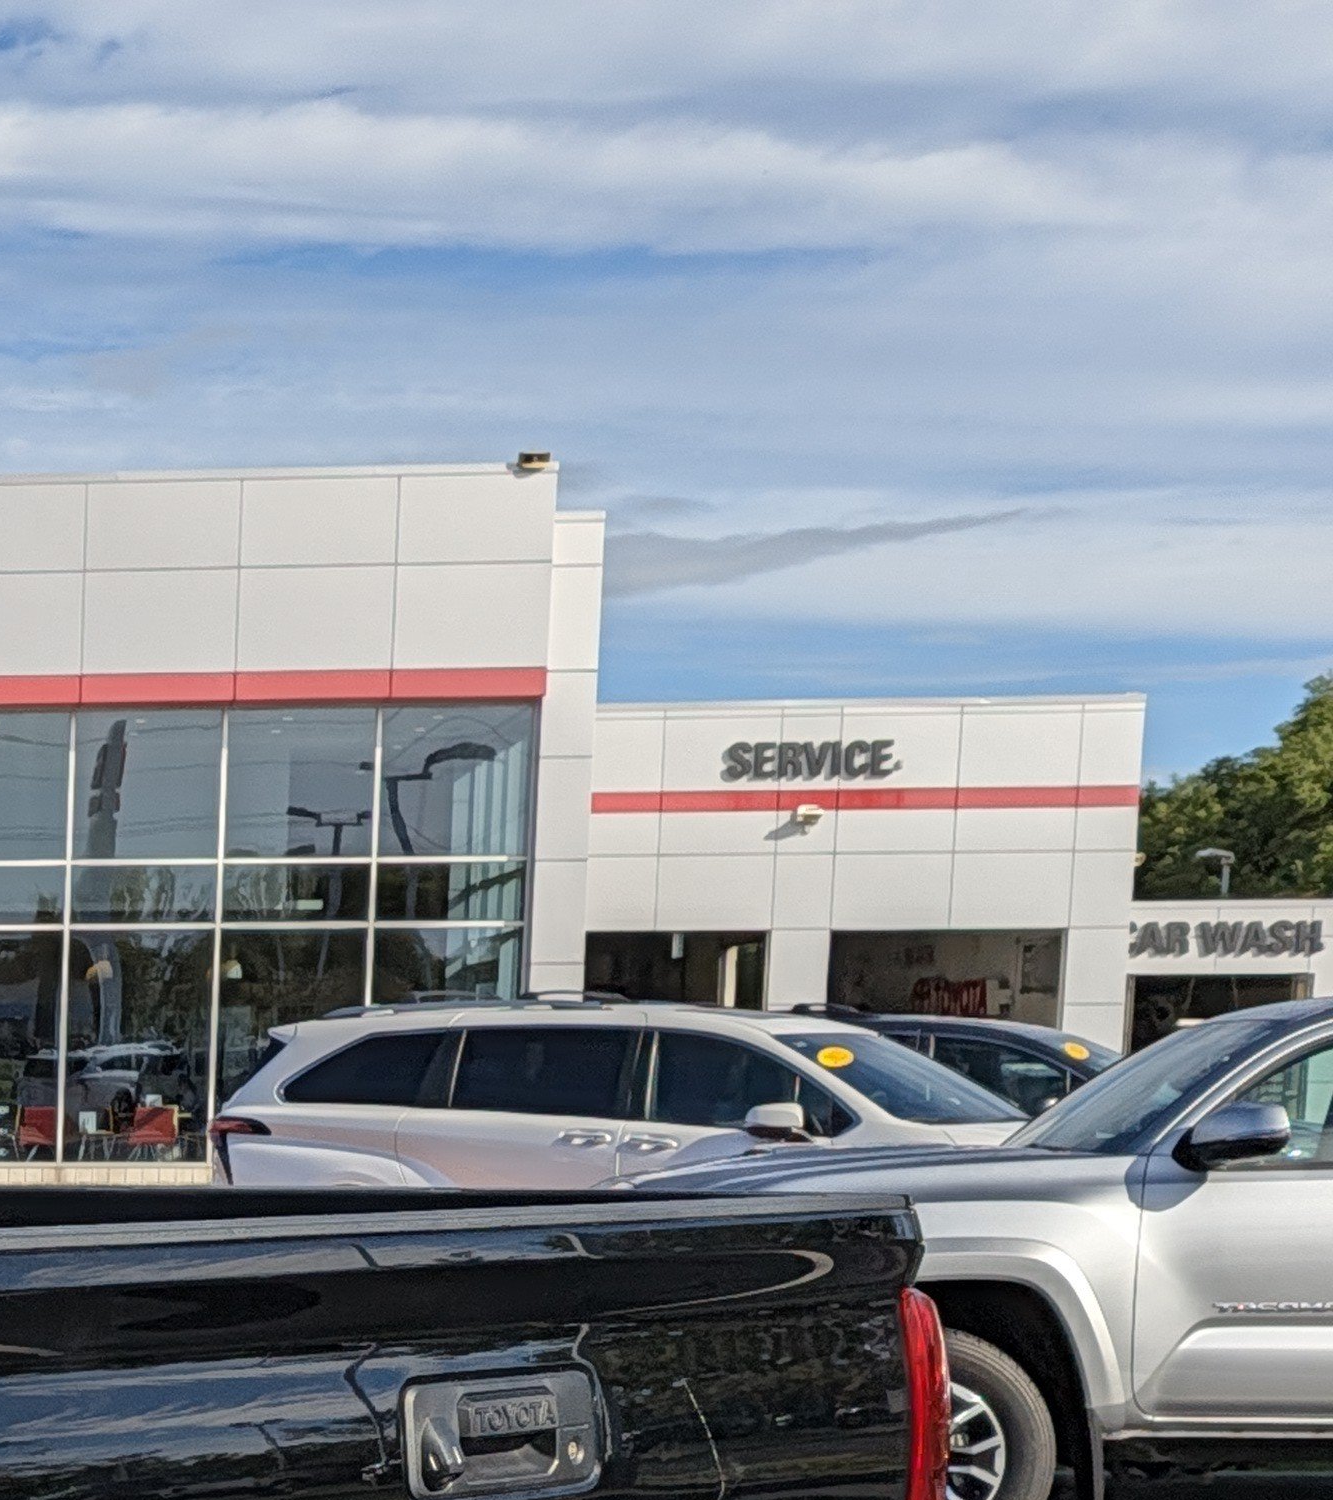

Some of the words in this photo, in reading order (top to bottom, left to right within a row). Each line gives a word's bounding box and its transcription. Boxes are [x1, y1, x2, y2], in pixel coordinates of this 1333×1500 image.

[723, 739, 897, 781] SERVICE
[1195, 919, 1325, 957] WASH
[474, 1399, 556, 1433] TOYOTA
